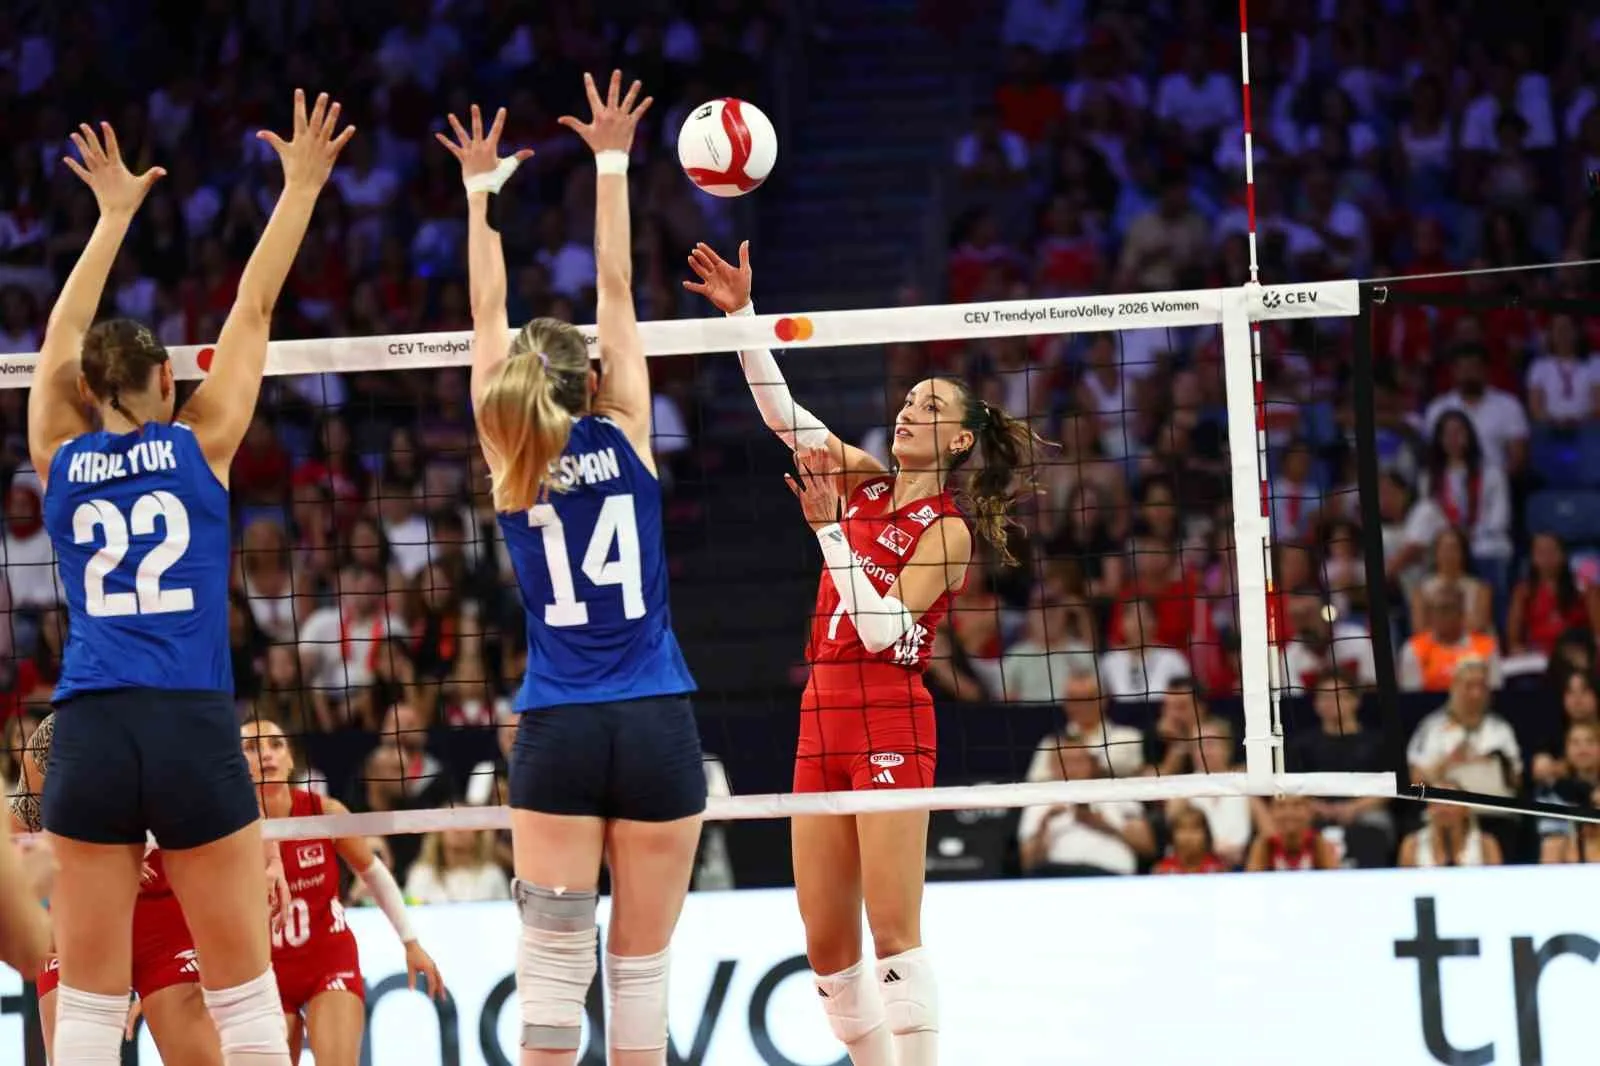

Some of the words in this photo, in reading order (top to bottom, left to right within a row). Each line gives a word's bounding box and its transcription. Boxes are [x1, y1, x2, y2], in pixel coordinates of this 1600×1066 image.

[1285, 291, 1318, 304] CEV
[964, 312, 990, 324] CEV
[993, 307, 1047, 322] Trendyol
[1049, 304, 1114, 319] EuroVolley
[1119, 303, 1149, 315] 2026
[1151, 301, 1199, 313] Women
[388, 343, 413, 355] CEV
[416, 339, 470, 355] Trendyol
[0, 362, 35, 374] Wome
[73, 491, 194, 617] 22
[528, 494, 647, 627] 14
[873, 754, 901, 763] gratis
